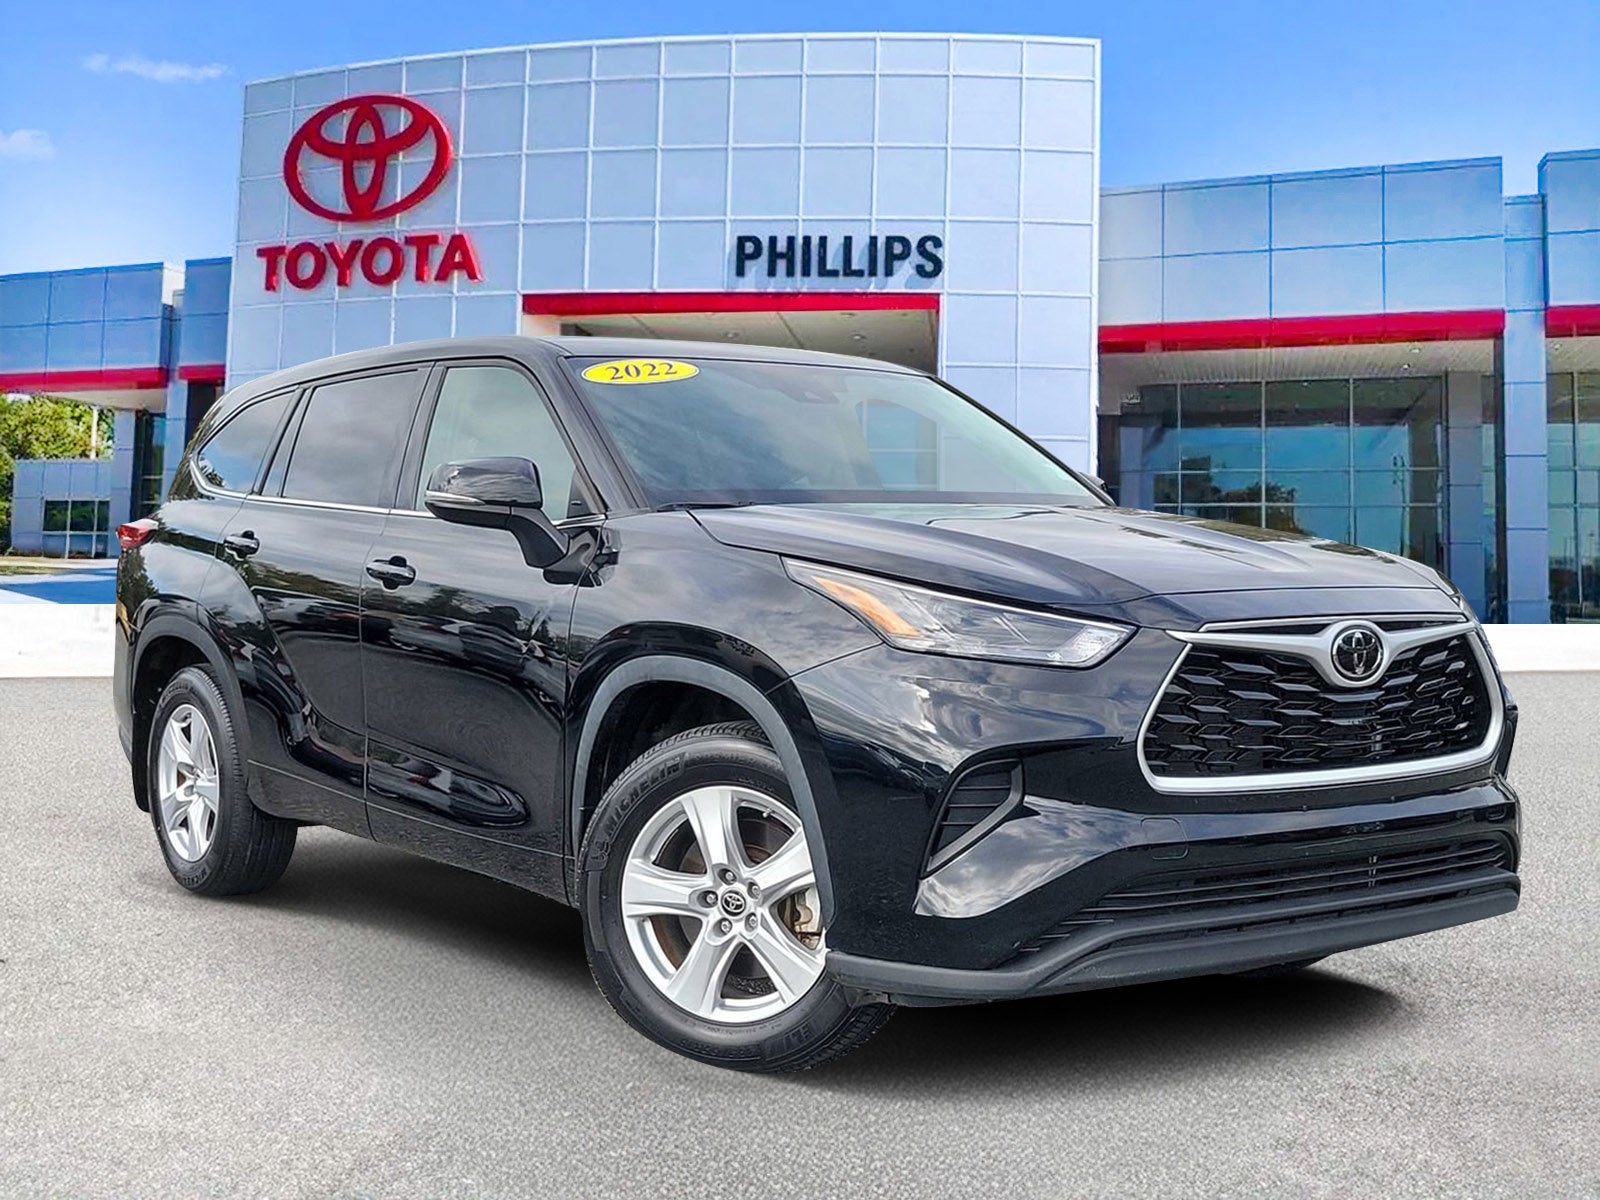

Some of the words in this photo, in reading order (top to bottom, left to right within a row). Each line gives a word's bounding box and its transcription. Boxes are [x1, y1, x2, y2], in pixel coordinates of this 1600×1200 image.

[256, 233, 482, 292] TOYOTA
[735, 235, 944, 279] PHILLIPS
[605, 362, 678, 380] 2022
